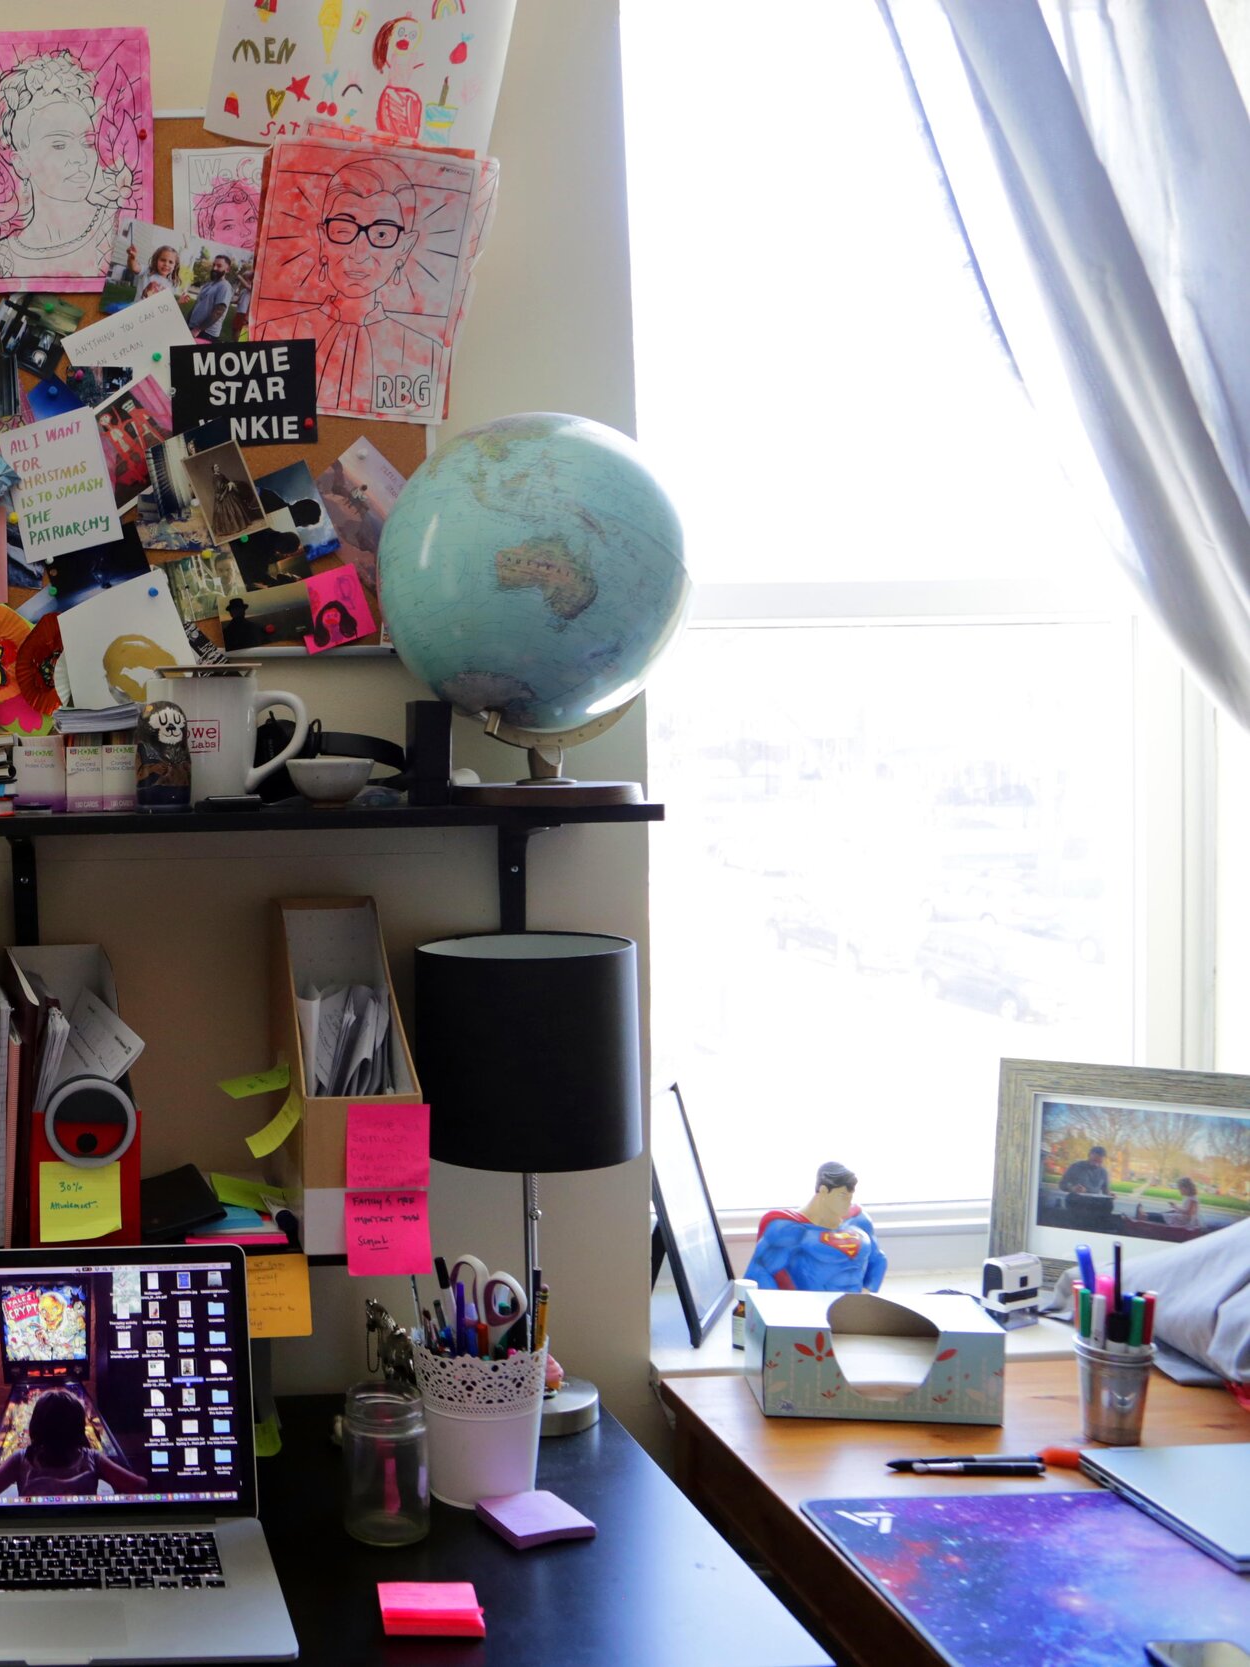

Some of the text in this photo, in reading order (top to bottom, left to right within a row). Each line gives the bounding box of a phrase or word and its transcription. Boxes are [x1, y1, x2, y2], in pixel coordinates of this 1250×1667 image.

[232, 36, 296, 64] MEN
[74, 332, 115, 358] ANYTHING
[119, 322, 135, 333] YOU
[138, 312, 155, 323] CAN
[112, 340, 144, 361] EXPLAIN
[192, 346, 290, 377] MOVIE
[209, 376, 286, 406] STAR
[376, 374, 431, 408] RBG
[10, 421, 83, 456] ALL I WANT
[199, 415, 299, 440] NKIE
[13, 457, 42, 473] FOR
[21, 477, 104, 509] IS TO SMASH
[23, 508, 52, 529] THE
[29, 515, 111, 546] PATRIARCHY
[191, 740, 216, 749] Labs
[59, 1181, 83, 1193] 30%
[6, 1294, 32, 1307] TALES
[8, 1303, 38, 1320] CRYPT
